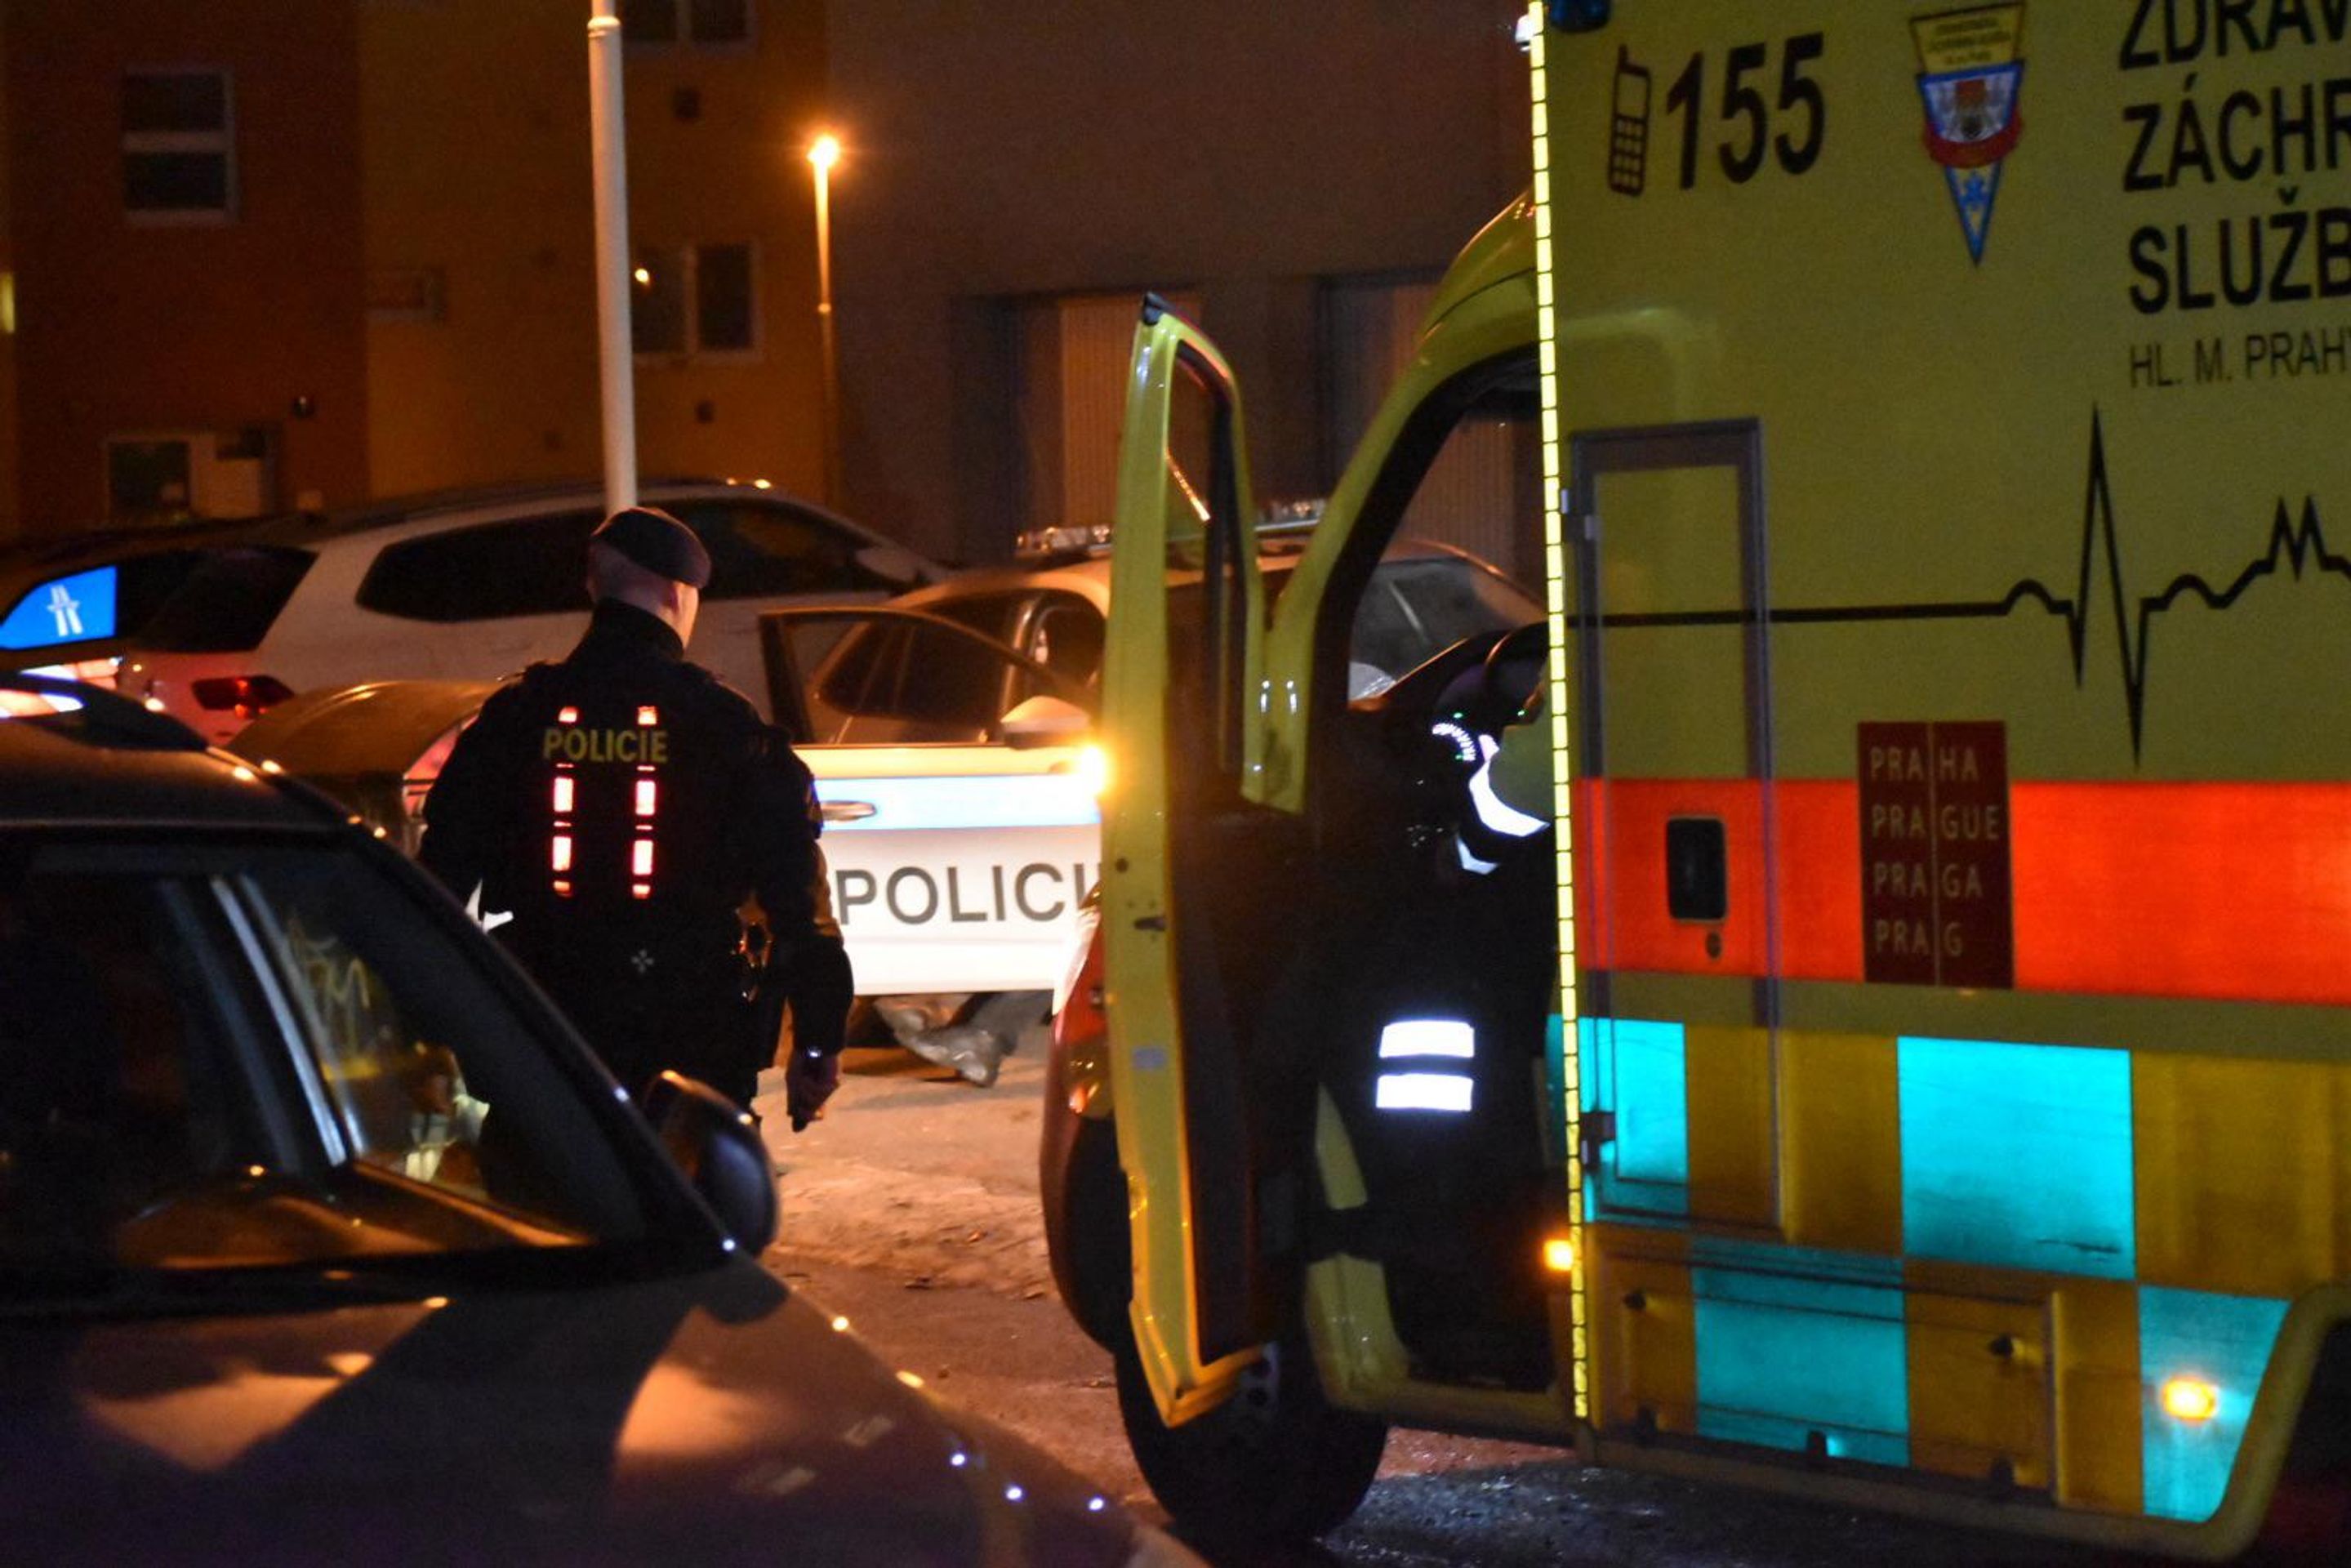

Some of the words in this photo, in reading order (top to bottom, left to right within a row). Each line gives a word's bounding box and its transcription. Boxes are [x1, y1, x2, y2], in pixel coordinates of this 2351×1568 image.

[1666, 31, 1826, 190] 155
[2123, 72, 2351, 192] ZÁCHR
[2129, 185, 2351, 315] SLUŽB
[2130, 341, 2183, 388] HL.
[2195, 336, 2233, 384] M.
[2246, 326, 2351, 379] PRAH
[543, 728, 669, 763] POLICIE
[835, 862, 1101, 925] POLICI
